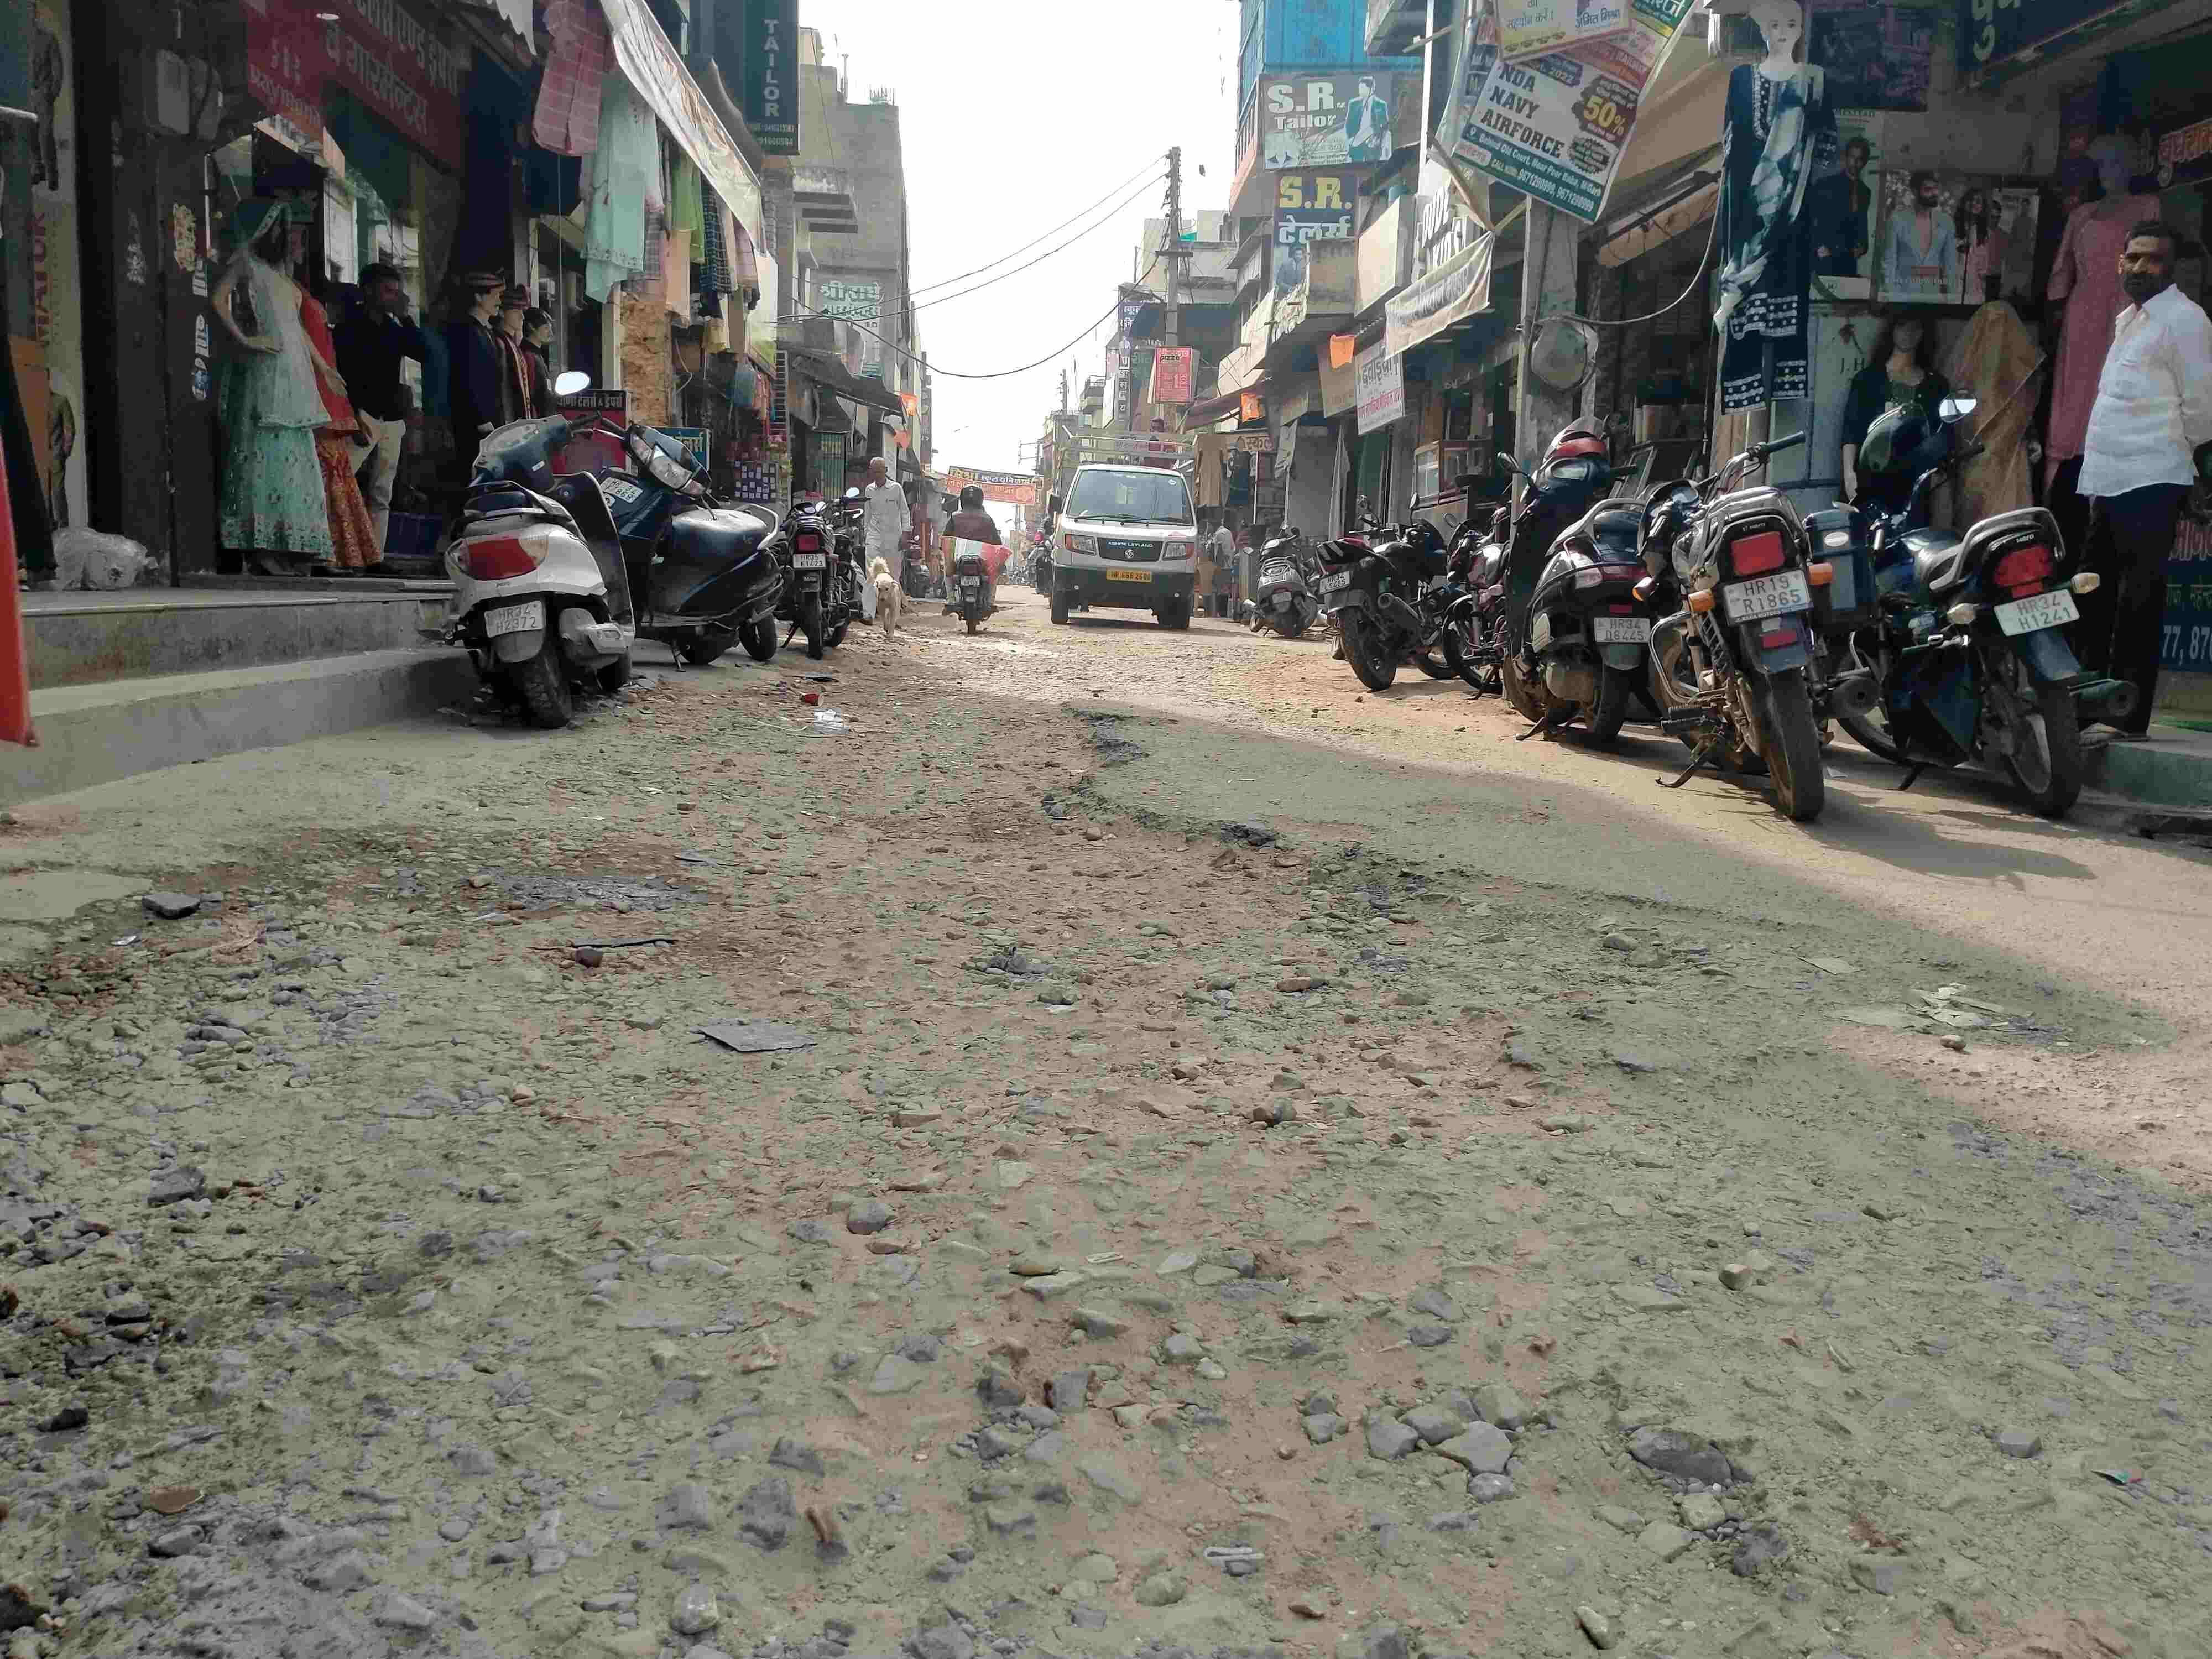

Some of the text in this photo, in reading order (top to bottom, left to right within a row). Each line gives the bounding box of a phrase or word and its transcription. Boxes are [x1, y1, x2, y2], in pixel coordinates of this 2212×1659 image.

[763, 19, 779, 117] TAILOR
[1498, 62, 1536, 92] NDA
[1489, 85, 1540, 119] NAVY
[1274, 114, 1337, 130] Tailor
[1583, 97, 1628, 136] 50%
[1480, 108, 1565, 159] AIRFORCE
[1279, 176, 1353, 209] S.R.
[1744, 575, 1790, 597] HR19
[499, 604, 531, 620] HR34
[1743, 589, 1801, 613] R1865
[2017, 594, 2061, 615] HR34
[1610, 619, 1641, 629] HR34
[2018, 607, 2071, 630] H1241
